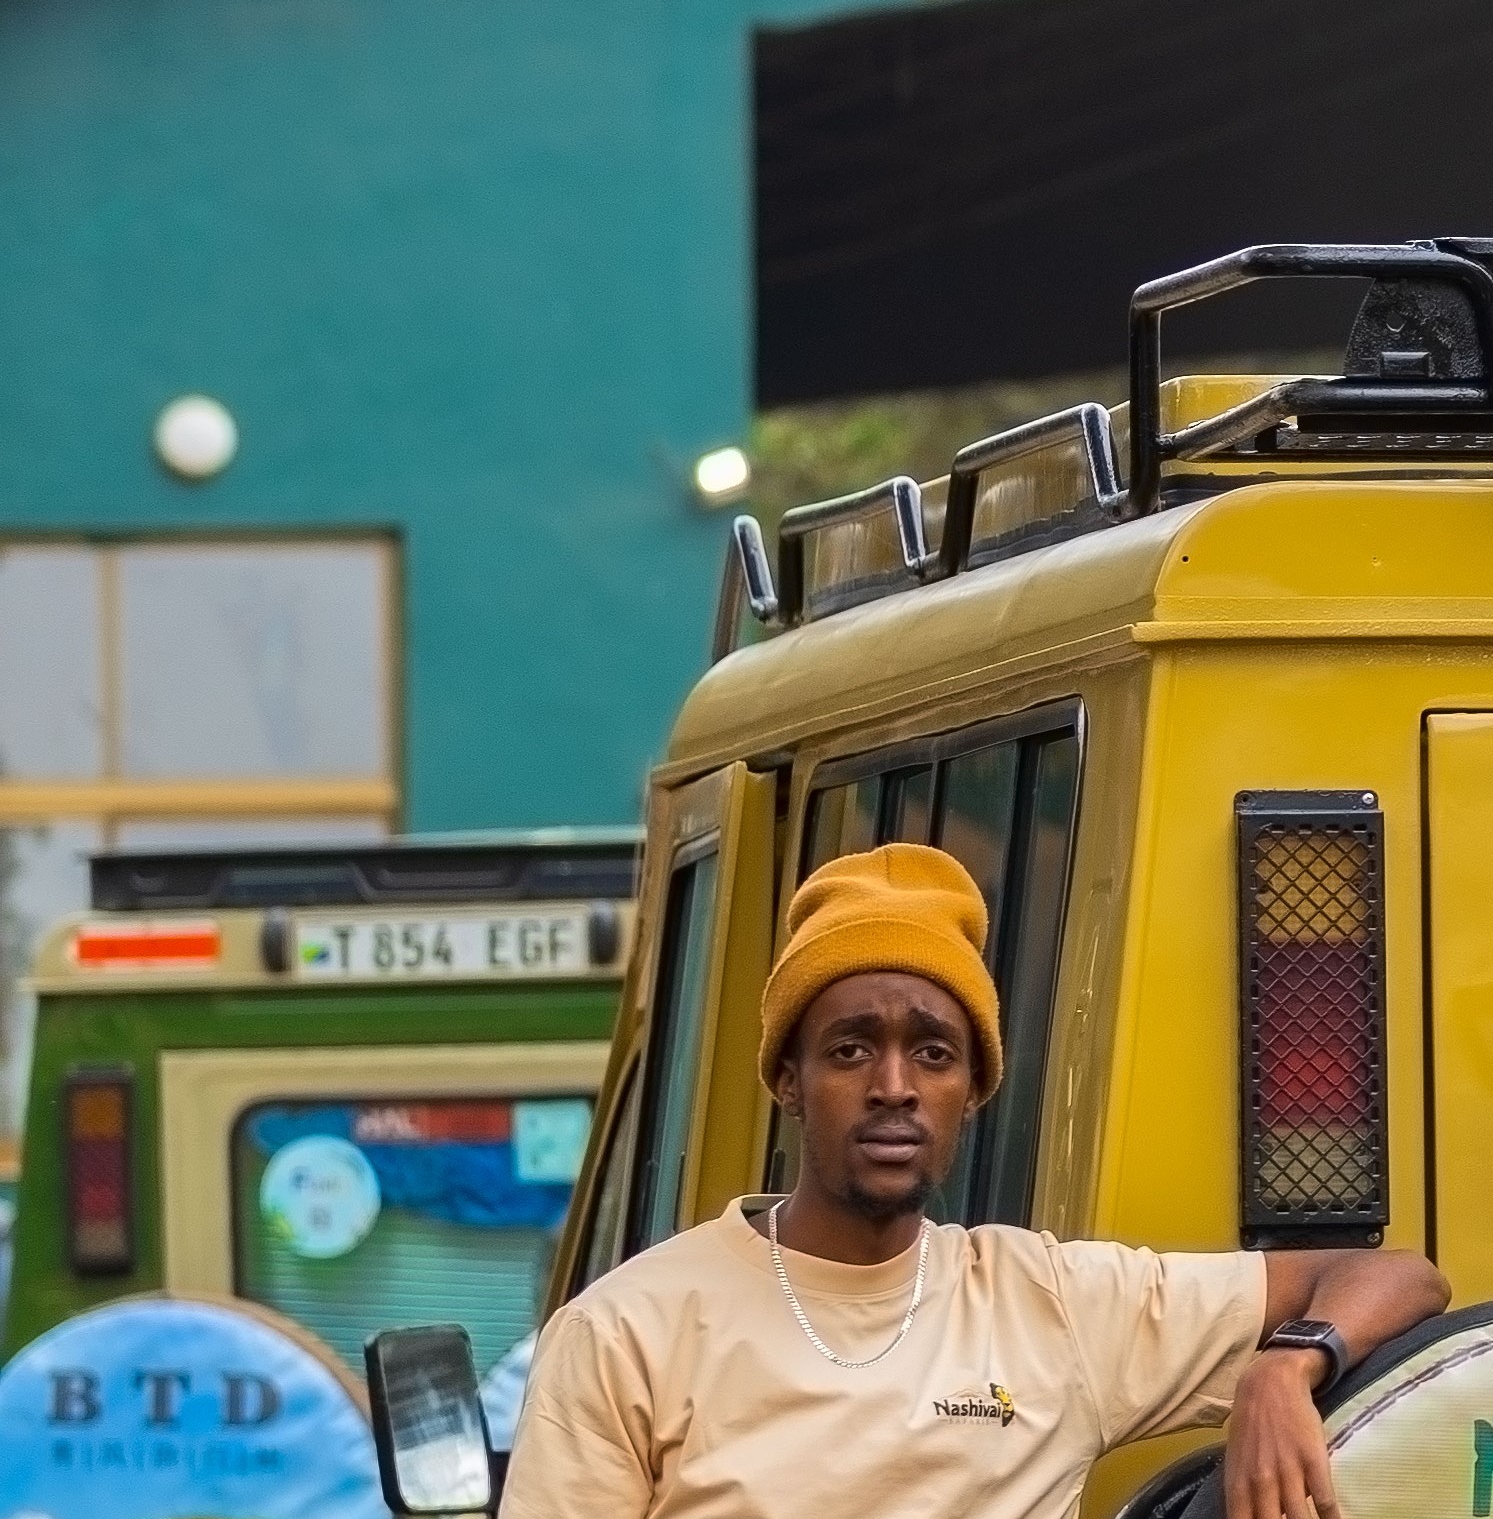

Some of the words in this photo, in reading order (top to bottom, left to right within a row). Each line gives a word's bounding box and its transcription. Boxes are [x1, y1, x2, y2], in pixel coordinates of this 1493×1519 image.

[331, 924, 357, 970] T
[372, 920, 454, 969] 854
[486, 917, 574, 965] EGF
[934, 1399, 1000, 1419] Nashivai
